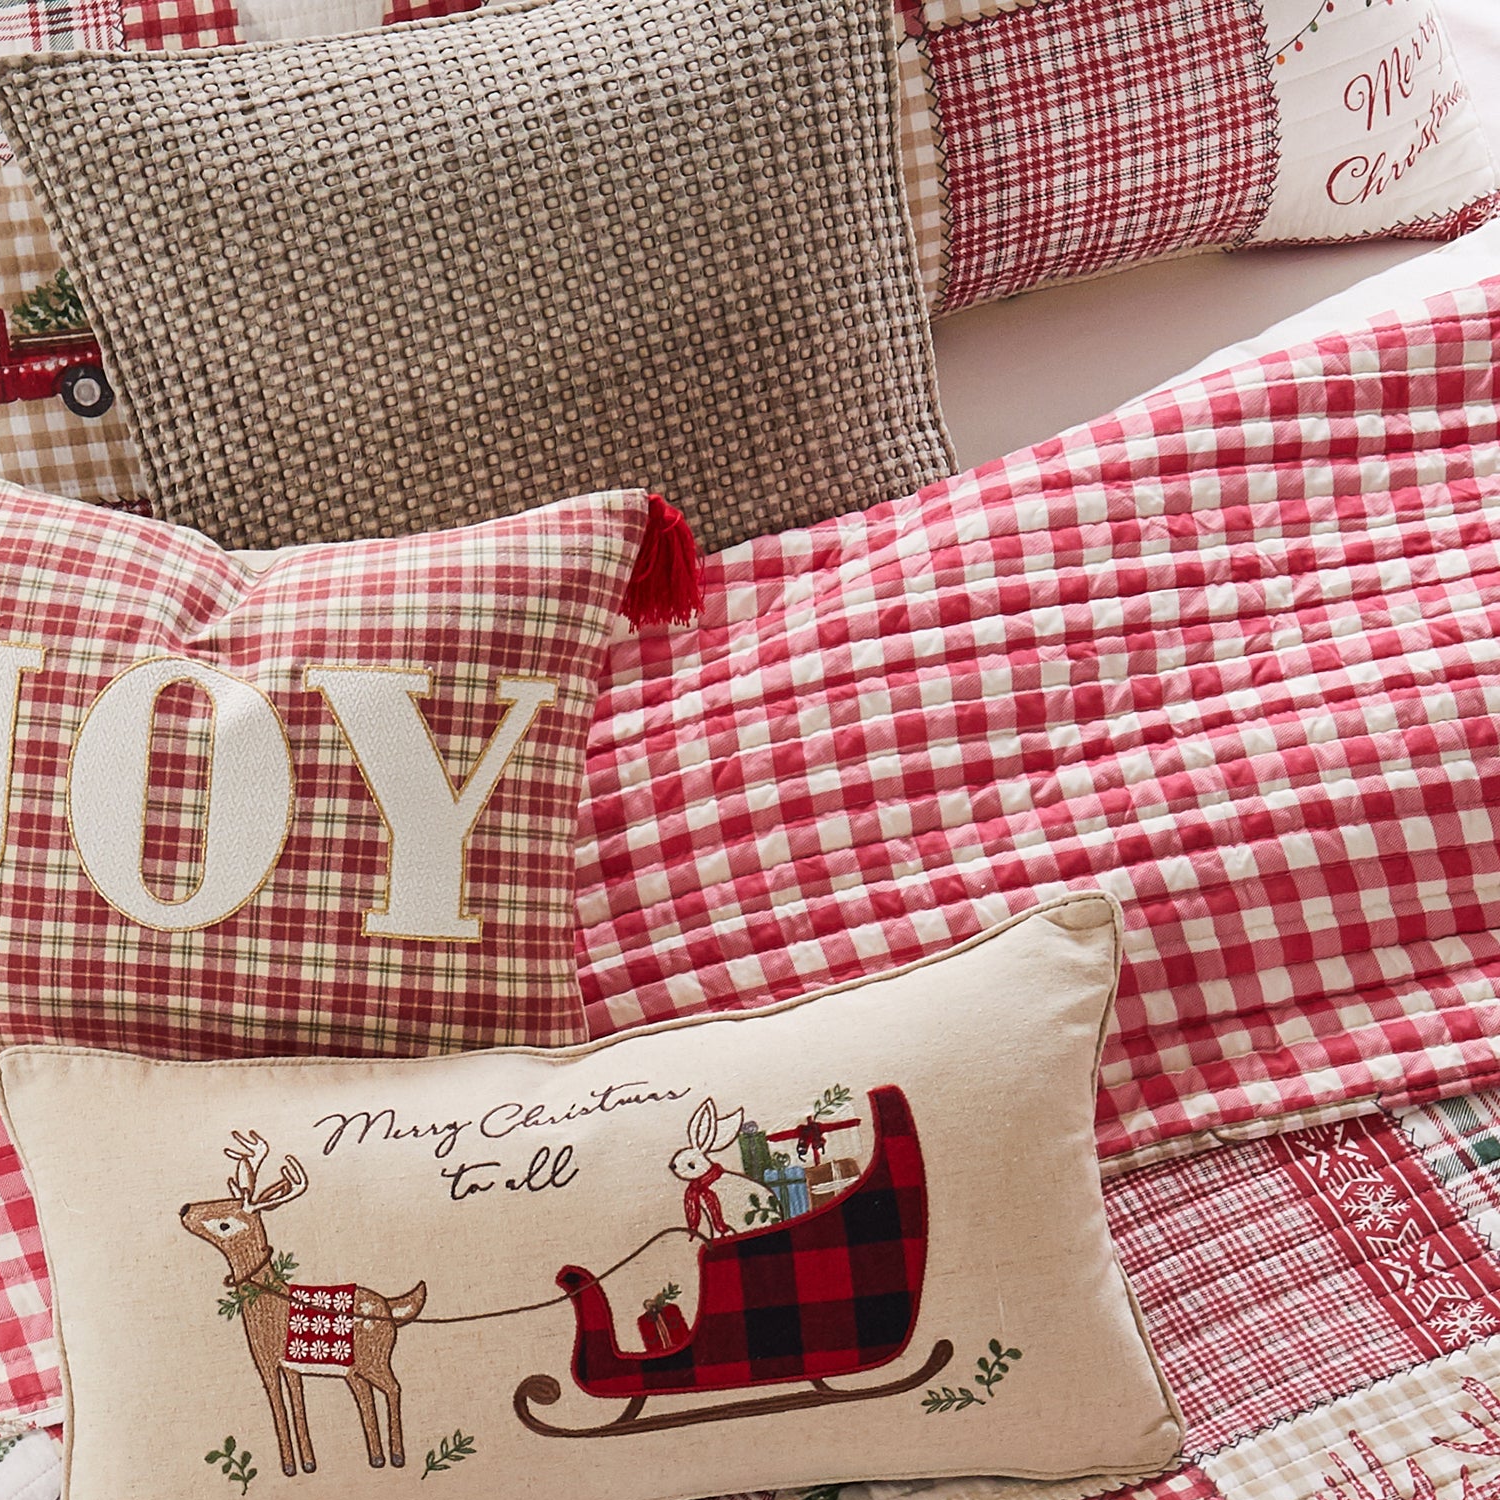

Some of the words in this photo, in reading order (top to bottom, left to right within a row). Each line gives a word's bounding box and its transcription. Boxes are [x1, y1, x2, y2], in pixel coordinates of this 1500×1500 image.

[1344, 9, 1442, 131] Merry
[313, 1109, 472, 1158] Merry
[480, 1081, 691, 1138] Christmas
[442, 1162, 500, 1200] to
[505, 1145, 580, 1192] all
